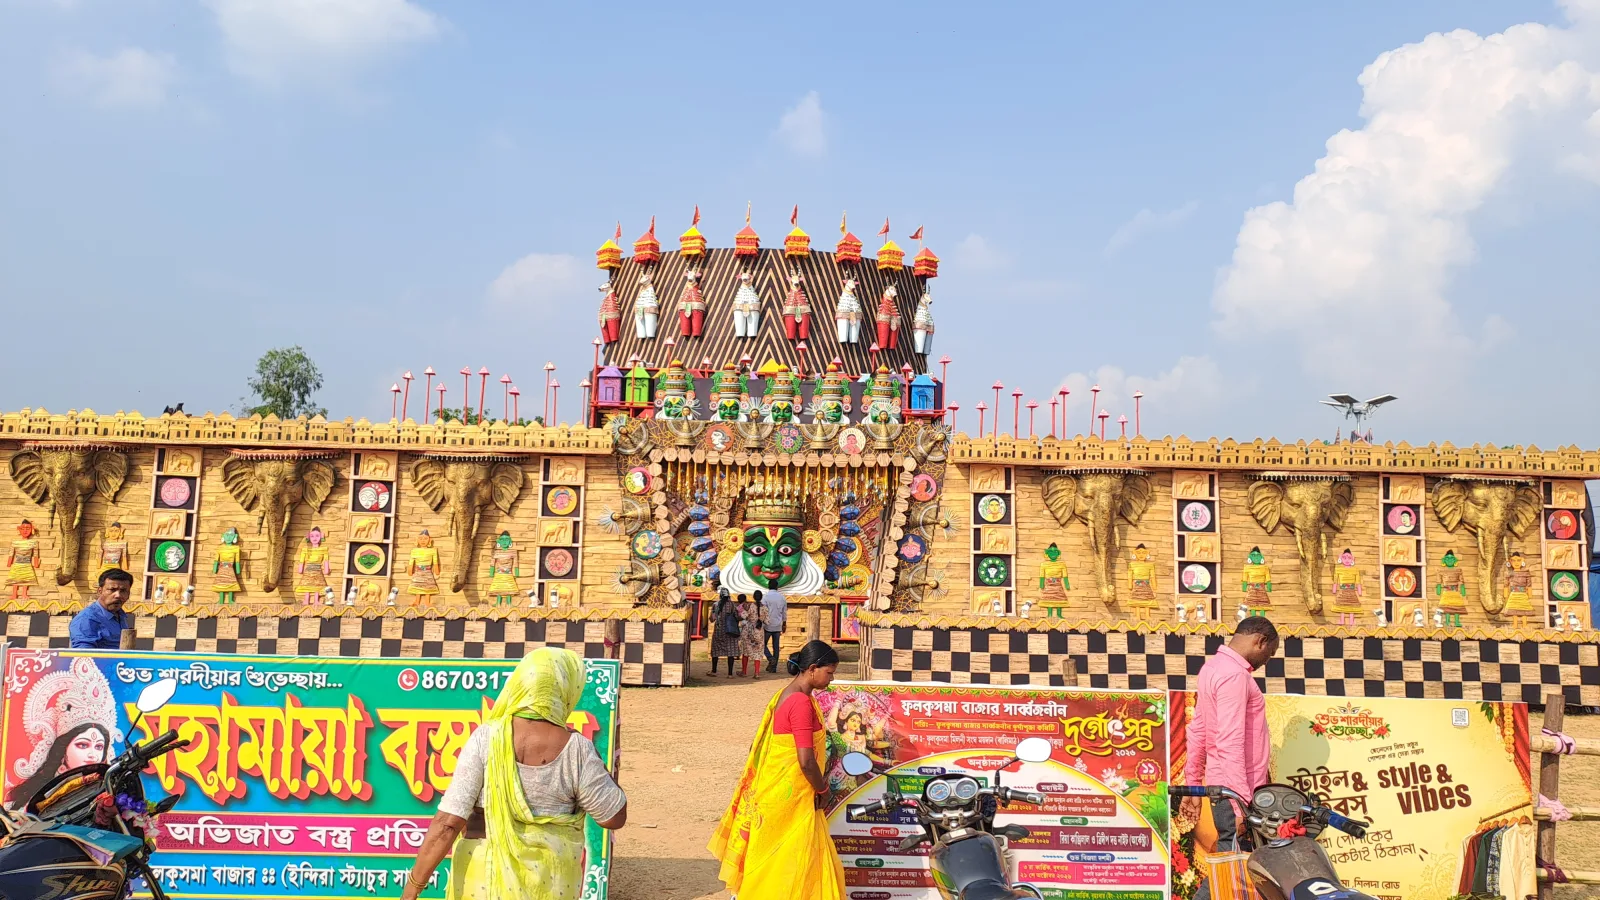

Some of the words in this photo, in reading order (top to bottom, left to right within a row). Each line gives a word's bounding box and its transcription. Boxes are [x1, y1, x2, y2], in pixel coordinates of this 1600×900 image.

[117, 662, 153, 683] শুভ
[422, 671, 512, 690] 8670317
[901, 700, 958, 716] ফুলকুসমা
[961, 701, 1000, 716] বাজার
[1315, 714, 1338, 726] শুভ
[1340, 712, 1383, 727] শারদীয়ার
[124, 691, 373, 804] মহামায়া
[1286, 766, 1349, 793] স্টাইল
[1378, 762, 1432, 789] style
[1436, 763, 1453, 783] &
[1397, 784, 1472, 815] vibes
[165, 816, 299, 847] অভিজাত
[306, 826, 357, 851] বস্ত্র
[367, 819, 429, 850] প্রতি
[1330, 847, 1371, 865] একটাই
[211, 864, 257, 885] বাজার
